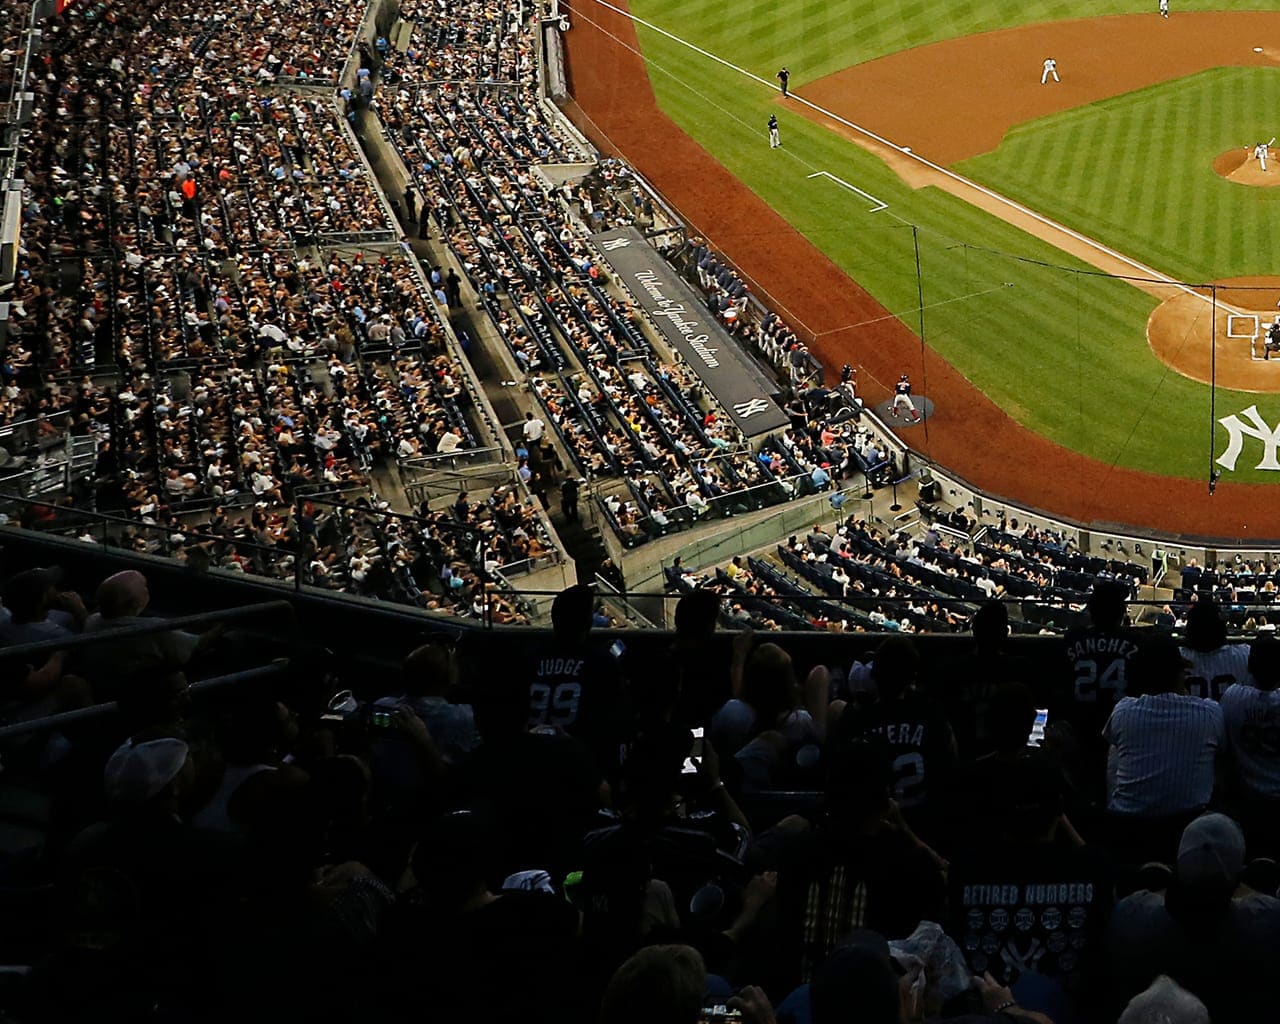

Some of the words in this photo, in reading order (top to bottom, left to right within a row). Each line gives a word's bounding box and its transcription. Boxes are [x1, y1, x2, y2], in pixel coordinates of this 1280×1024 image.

[634, 269, 666, 304] Welcome
[653, 303, 698, 336] Yankee
[685, 332, 720, 369] Stadium
[1066, 637, 1140, 662] SANCHEZ
[536, 657, 585, 677] JUDGE
[1073, 657, 1129, 703] 24
[962, 882, 1021, 905] RETIRED
[1024, 880, 1095, 905] NUMBERS
